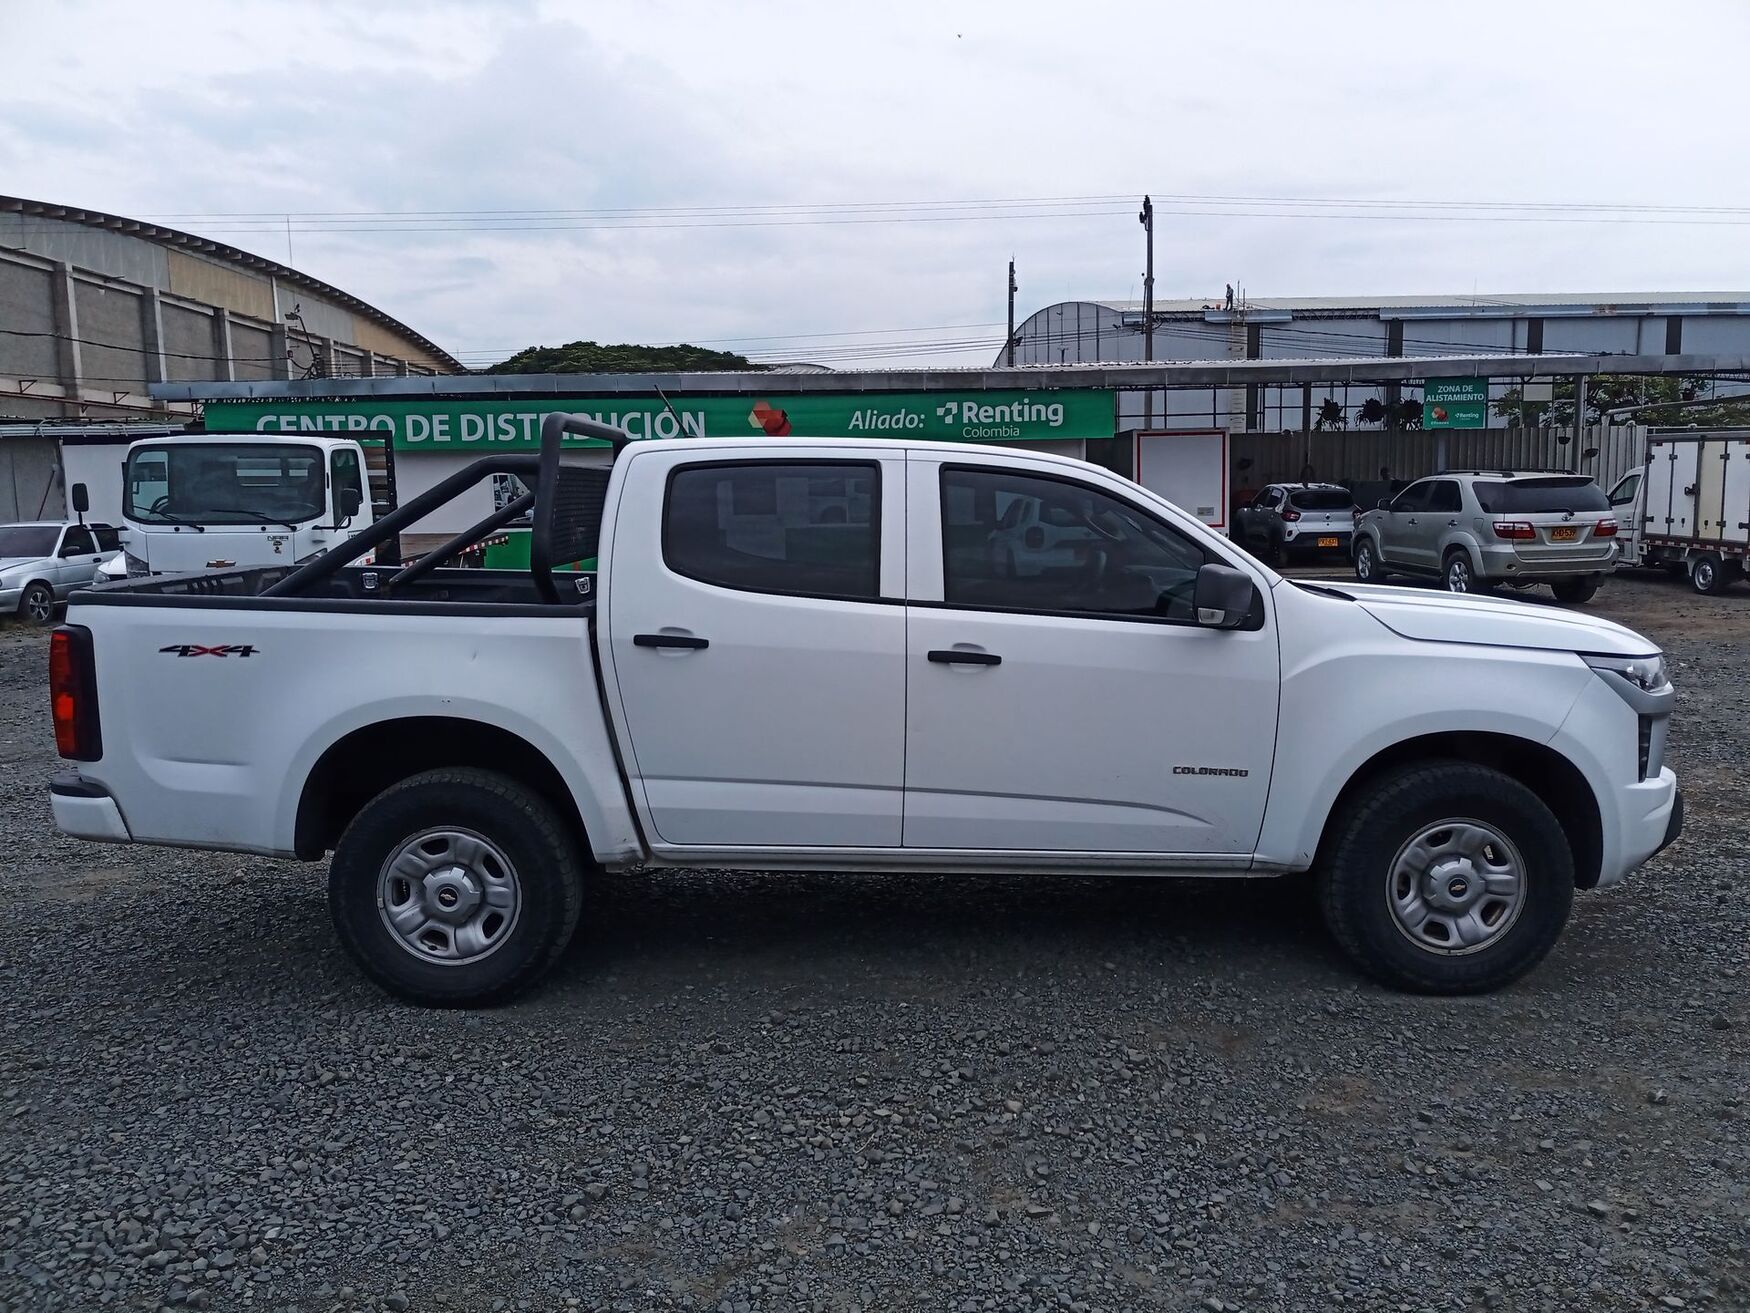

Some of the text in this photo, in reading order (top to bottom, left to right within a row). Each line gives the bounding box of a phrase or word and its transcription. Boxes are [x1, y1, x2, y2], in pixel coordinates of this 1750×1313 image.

[1437, 385, 1460, 393] ZONA
[1426, 393, 1484, 401] ALISTAMIENTO
[962, 398, 1064, 426] Renting
[405, 414, 450, 442] DE
[460, 406, 706, 442] DISTCIÓN
[848, 408, 925, 430] Aliado:
[962, 425, 1020, 438] Colombia
[1172, 766, 1249, 777] COLORADO
